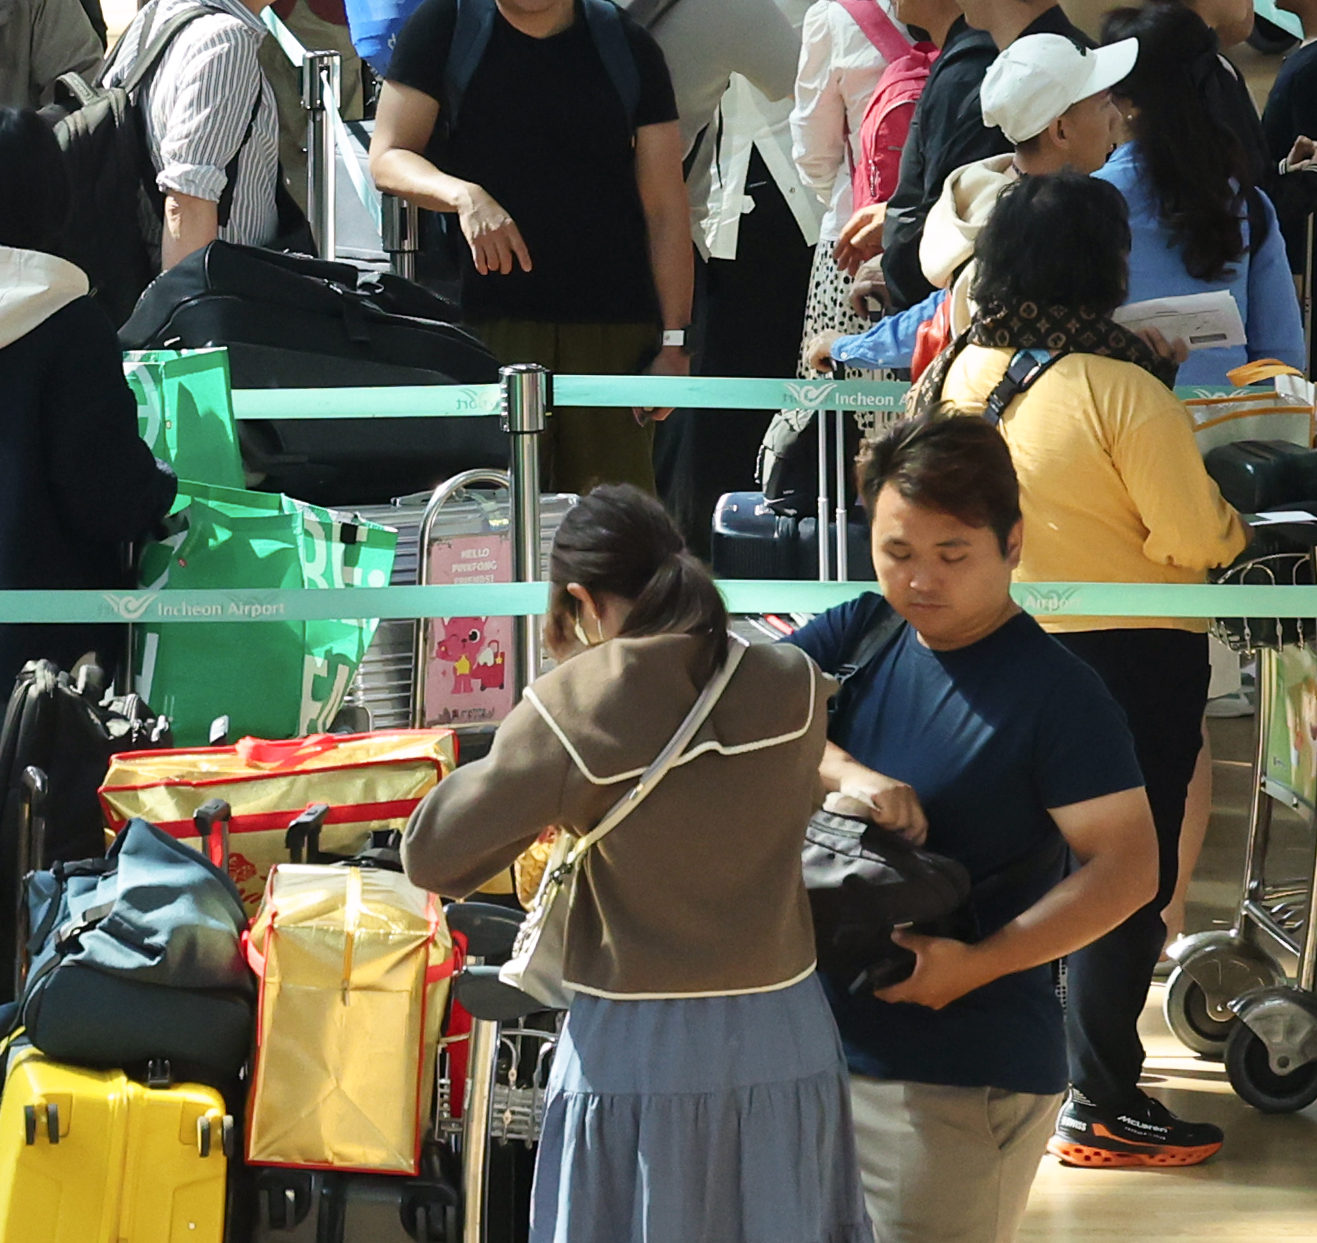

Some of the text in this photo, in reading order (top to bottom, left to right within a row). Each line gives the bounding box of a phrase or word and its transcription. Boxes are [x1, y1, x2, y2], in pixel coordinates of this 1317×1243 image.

[835, 391, 894, 406] Incheon
[461, 548, 491, 560] HELLO
[451, 561, 498, 574] PINKFONG
[157, 602, 285, 620] Incheon Airport
[1117, 1114, 1169, 1134] McLaren
